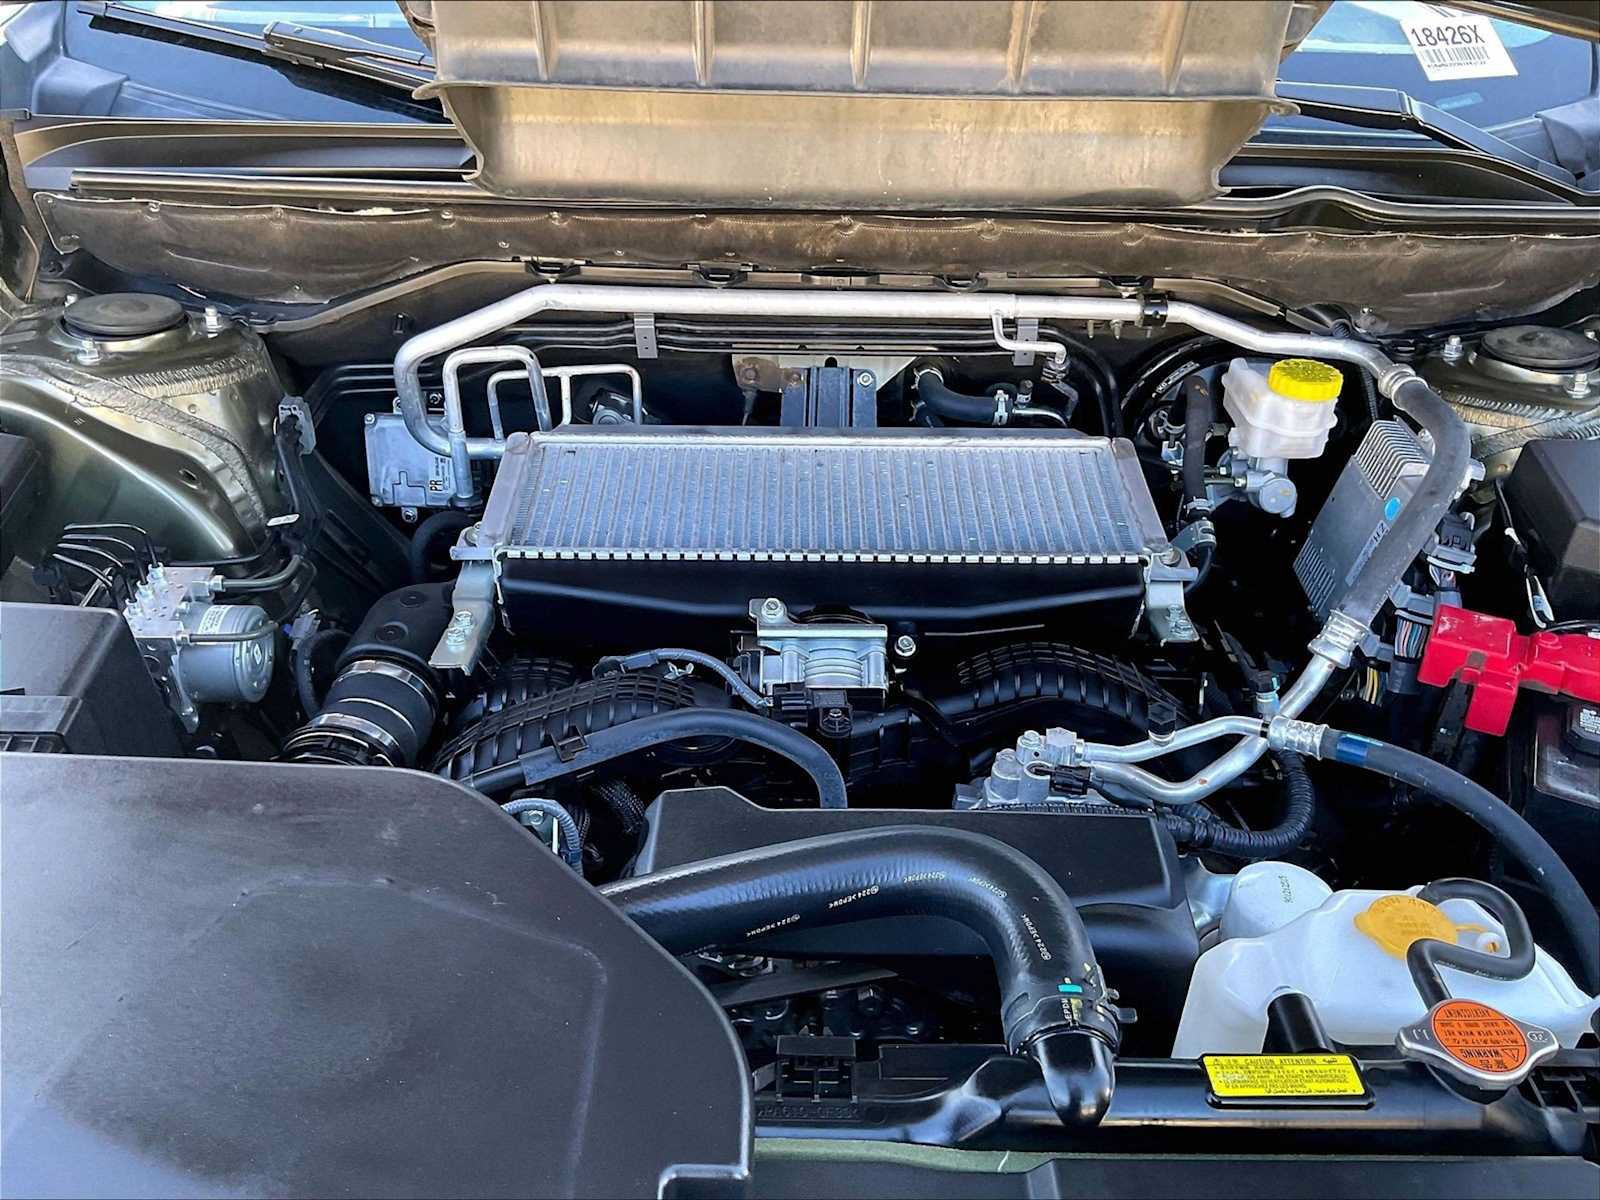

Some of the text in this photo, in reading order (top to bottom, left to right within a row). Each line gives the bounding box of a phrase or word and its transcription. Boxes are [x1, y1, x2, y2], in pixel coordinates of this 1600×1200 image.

[1411, 24, 1486, 47] 18426X
[429, 480, 443, 491] PR
[1460, 1048, 1502, 1058] WARNING
